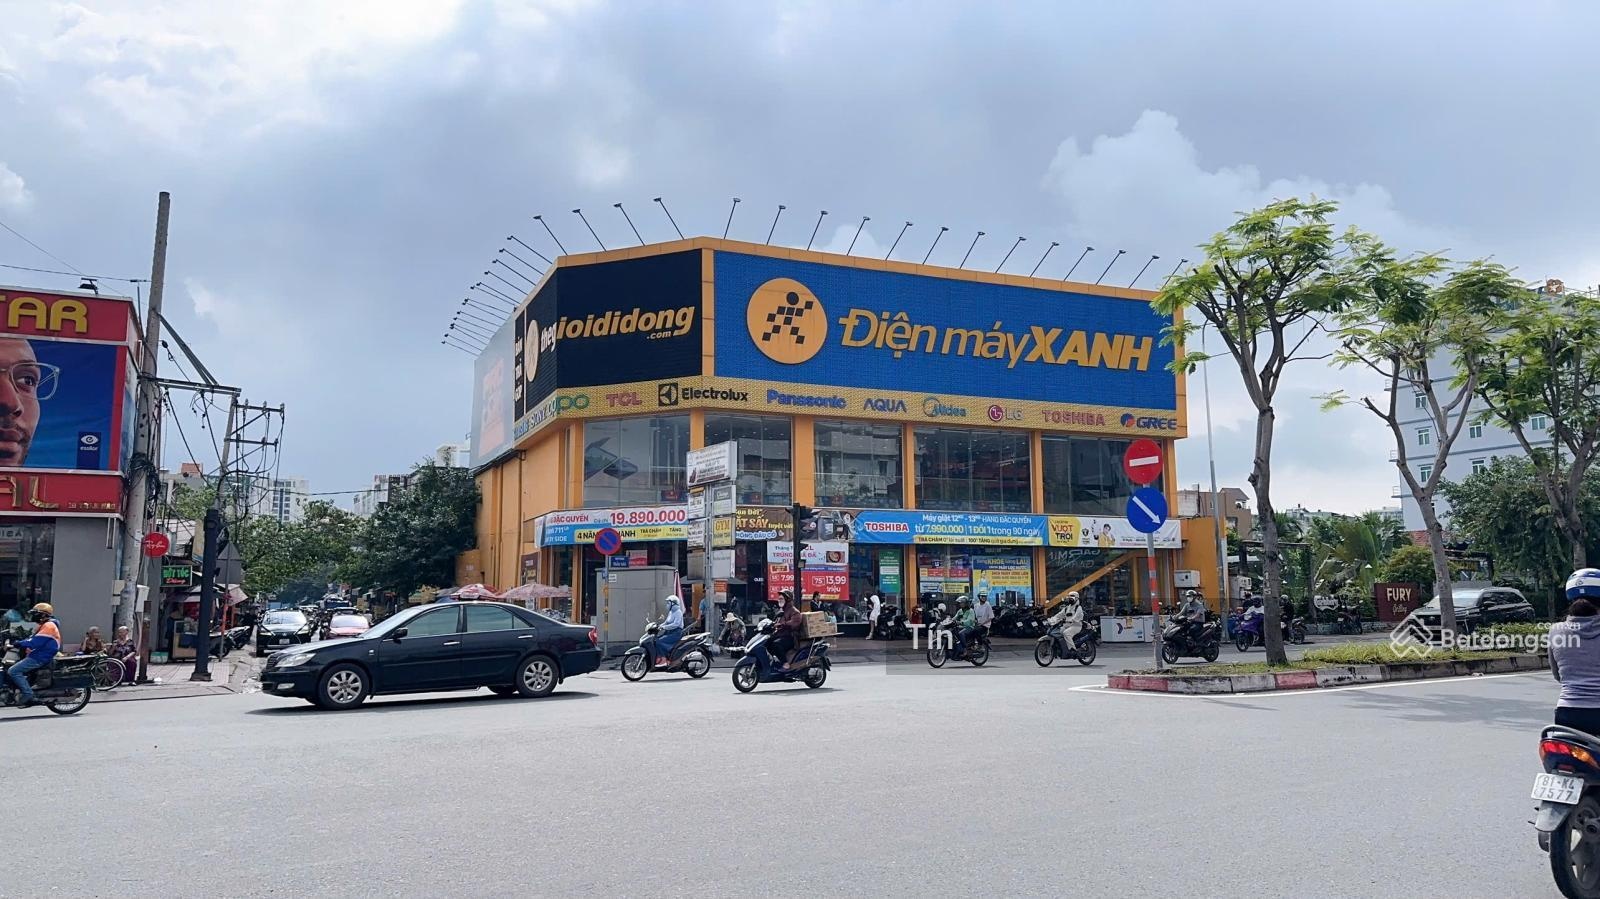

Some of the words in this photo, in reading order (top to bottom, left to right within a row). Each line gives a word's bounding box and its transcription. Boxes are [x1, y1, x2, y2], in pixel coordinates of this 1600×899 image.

[0, 295, 88, 333] AR
[540, 306, 695, 353] thegioididong
[646, 331, 672, 341] .com
[839, 308, 938, 359] Điện
[606, 391, 642, 407] TCL
[681, 386, 748, 403] Electrolux
[766, 388, 847, 409] Panasonic
[863, 397, 907, 413] AQUA
[928, 401, 966, 418] Midea
[1004, 408, 1024, 421] LG
[1041, 409, 1106, 426] TOSHIBA
[1136, 416, 1177, 431] GREE
[610, 509, 686, 525] 19.890.000
[715, 519, 730, 531] GYM
[922, 513, 937, 523] Máy
[865, 522, 909, 532] TOSHIBA
[991, 527, 1012, 536] trong
[1013, 527, 1022, 535] 90
[1386, 587, 1412, 602] FURY
[1540, 787, 1574, 801] 7577
